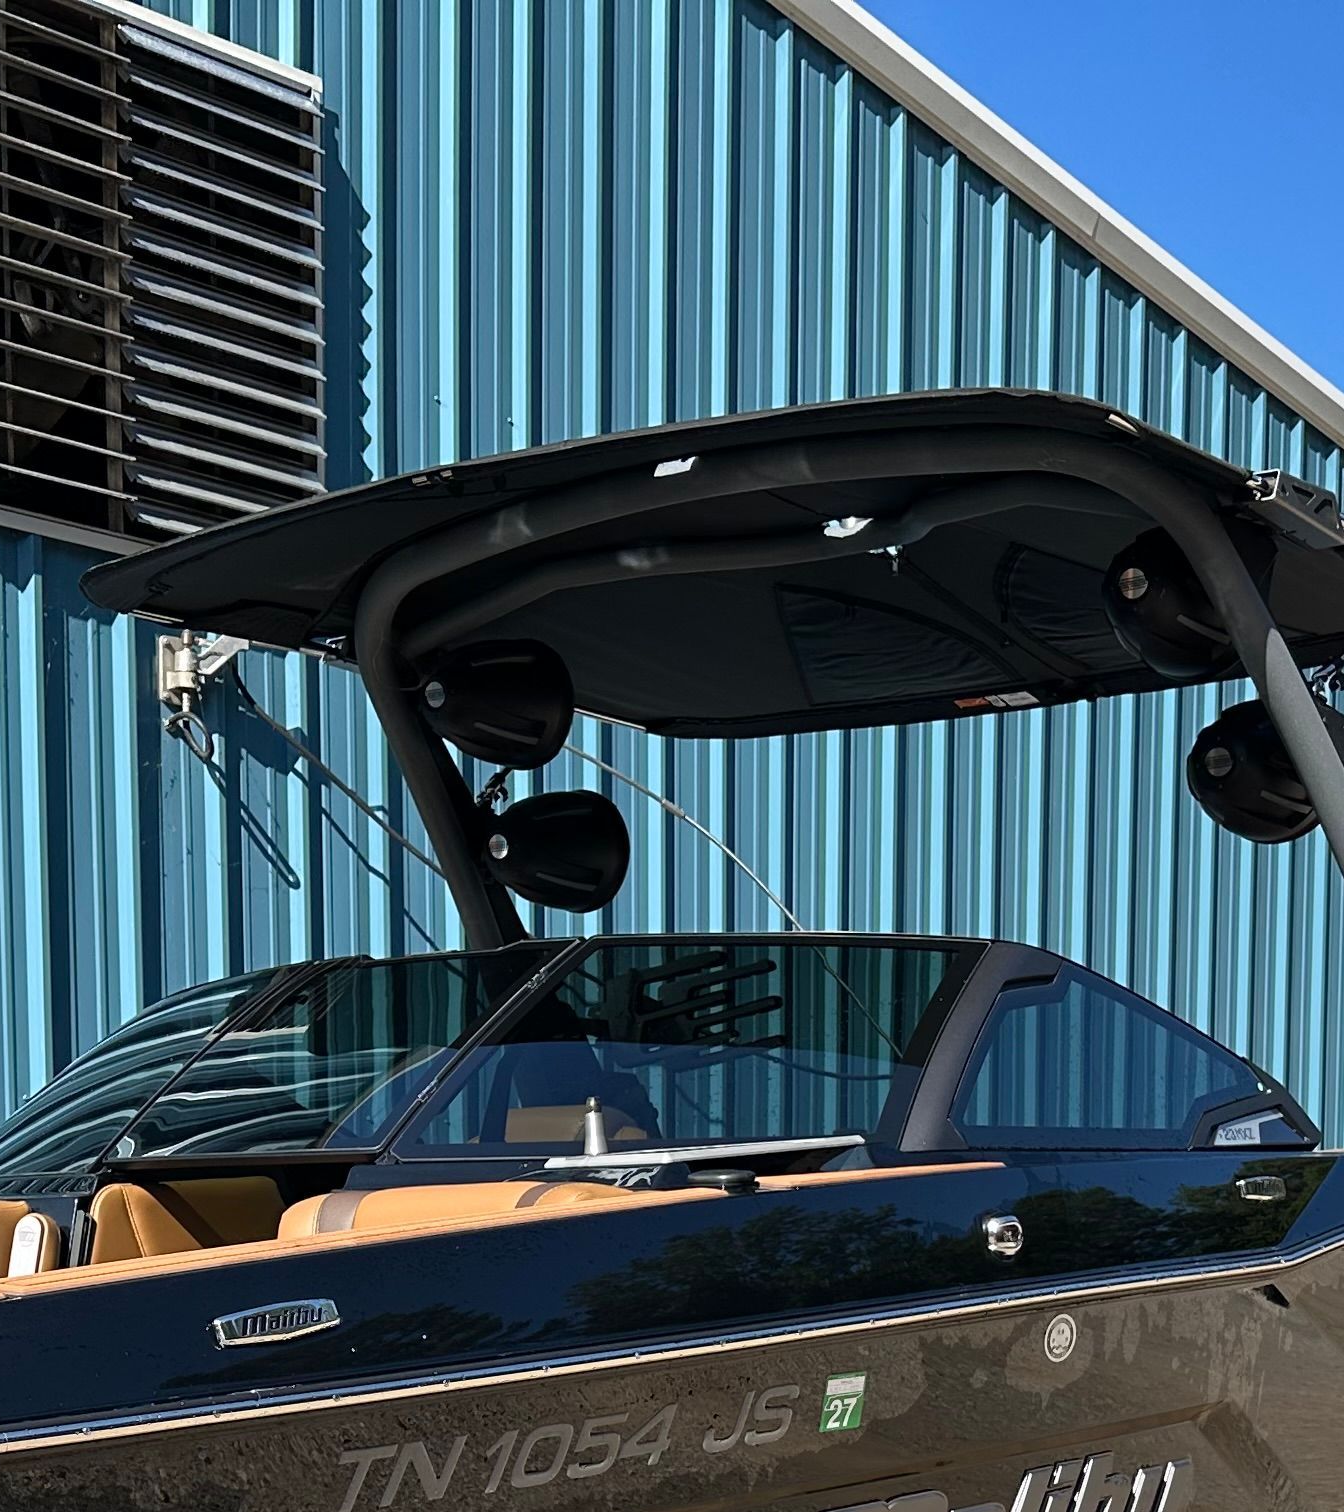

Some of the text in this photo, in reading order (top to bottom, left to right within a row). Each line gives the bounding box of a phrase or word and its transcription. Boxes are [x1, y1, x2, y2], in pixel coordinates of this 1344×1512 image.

[241, 1306, 326, 1337] Malibu
[826, 1397, 858, 1429] 27
[484, 1403, 678, 1494] 1054
[702, 1384, 801, 1454] JS
